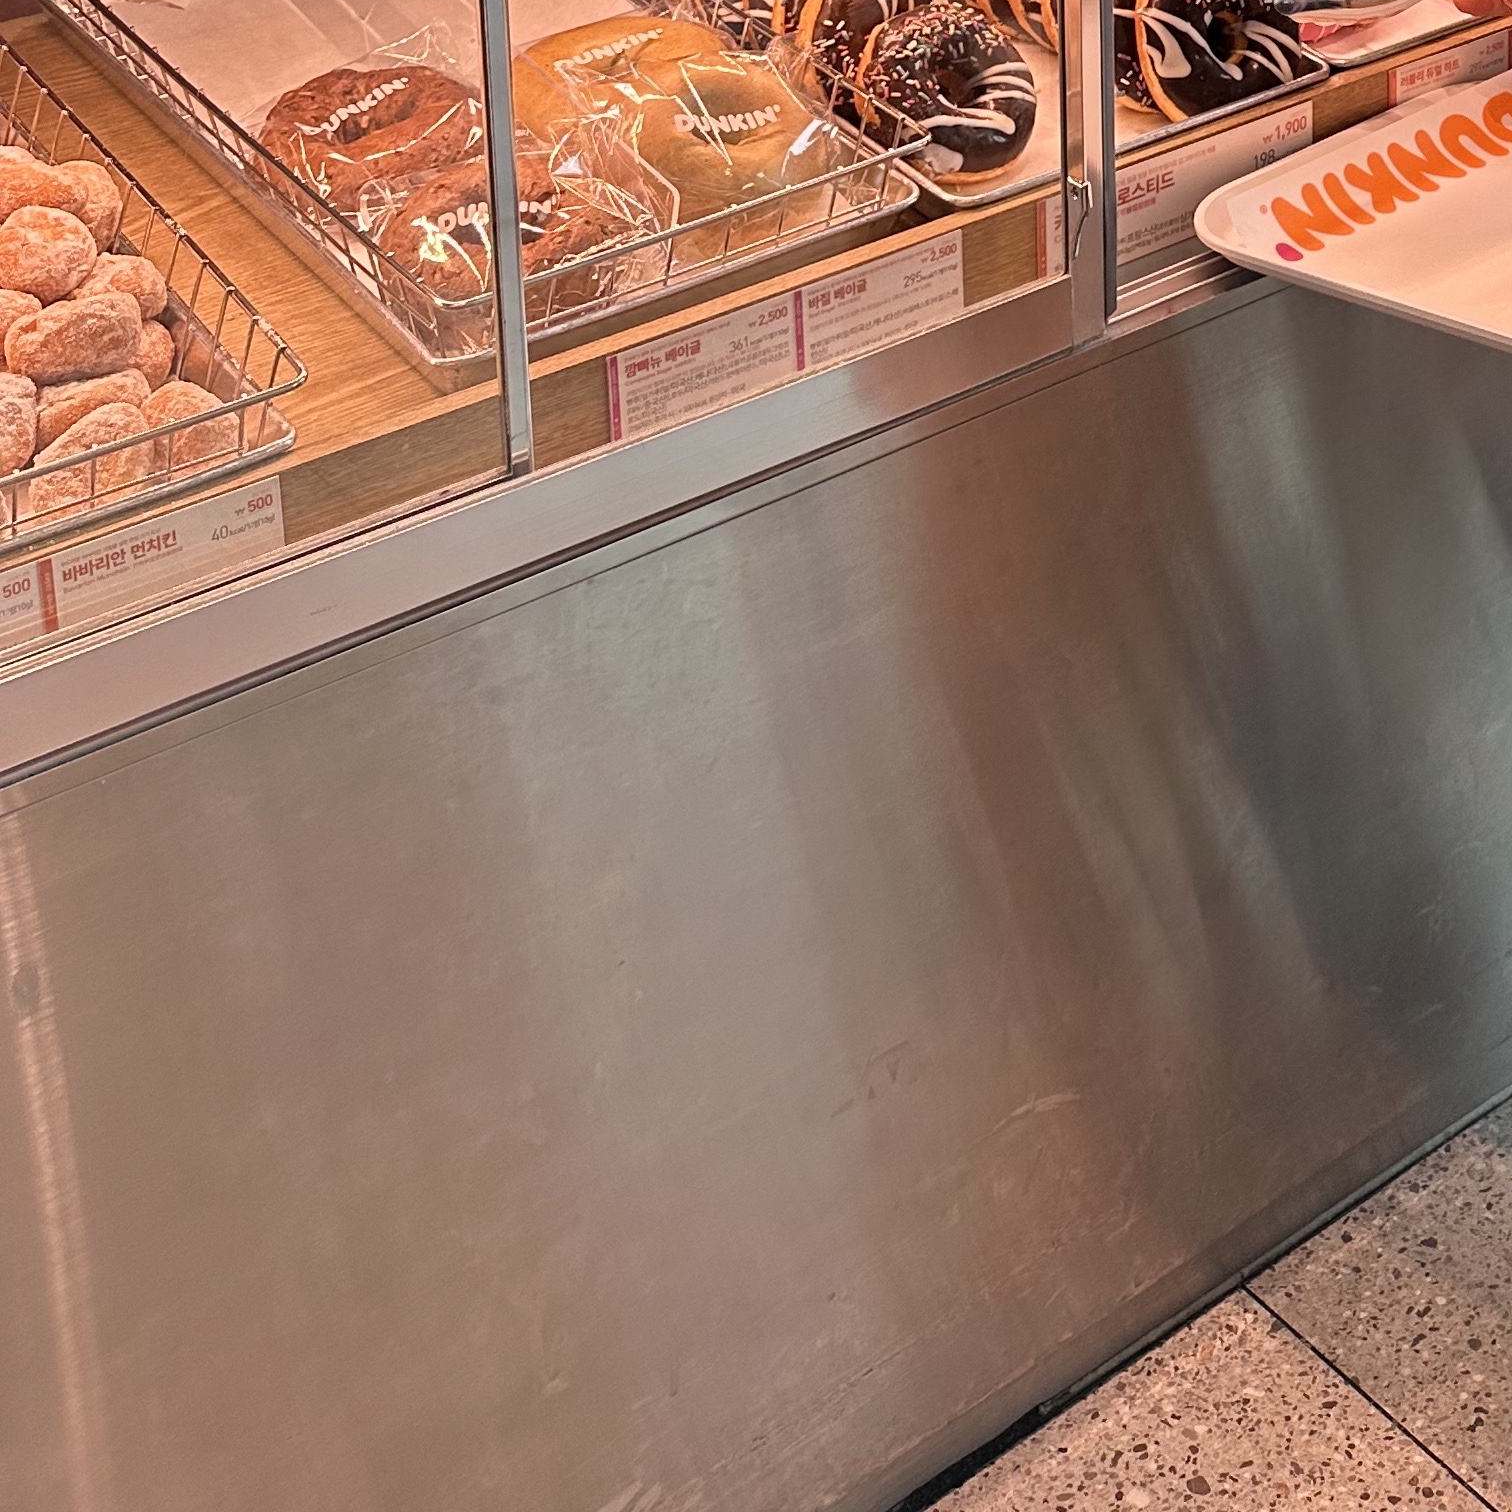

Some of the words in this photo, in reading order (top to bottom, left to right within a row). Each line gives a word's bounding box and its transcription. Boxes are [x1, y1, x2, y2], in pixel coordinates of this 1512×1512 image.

[554, 28, 663, 70] DUNKIN'
[294, 77, 409, 136] DUNKIN'
[674, 104, 780, 134] DUNKIN'
[1274, 115, 1307, 140] 1,900
[1254, 149, 1276, 172] 198
[929, 243, 958, 263] 2,500
[903, 271, 921, 289] 295
[808, 291, 831, 309] 바질
[834, 278, 867, 300] 베이글
[758, 306, 788, 327] 2,500
[729, 336, 749, 354] 361
[625, 355, 662, 378] 깜빠뉴
[665, 339, 701, 362] 베이글
[247, 494, 274, 512] 500
[211, 525, 228, 542] 40
[62, 549, 126, 583] 바바리안
[130, 530, 178, 560] 먼치킨
[2, 577, 31, 598] 500
